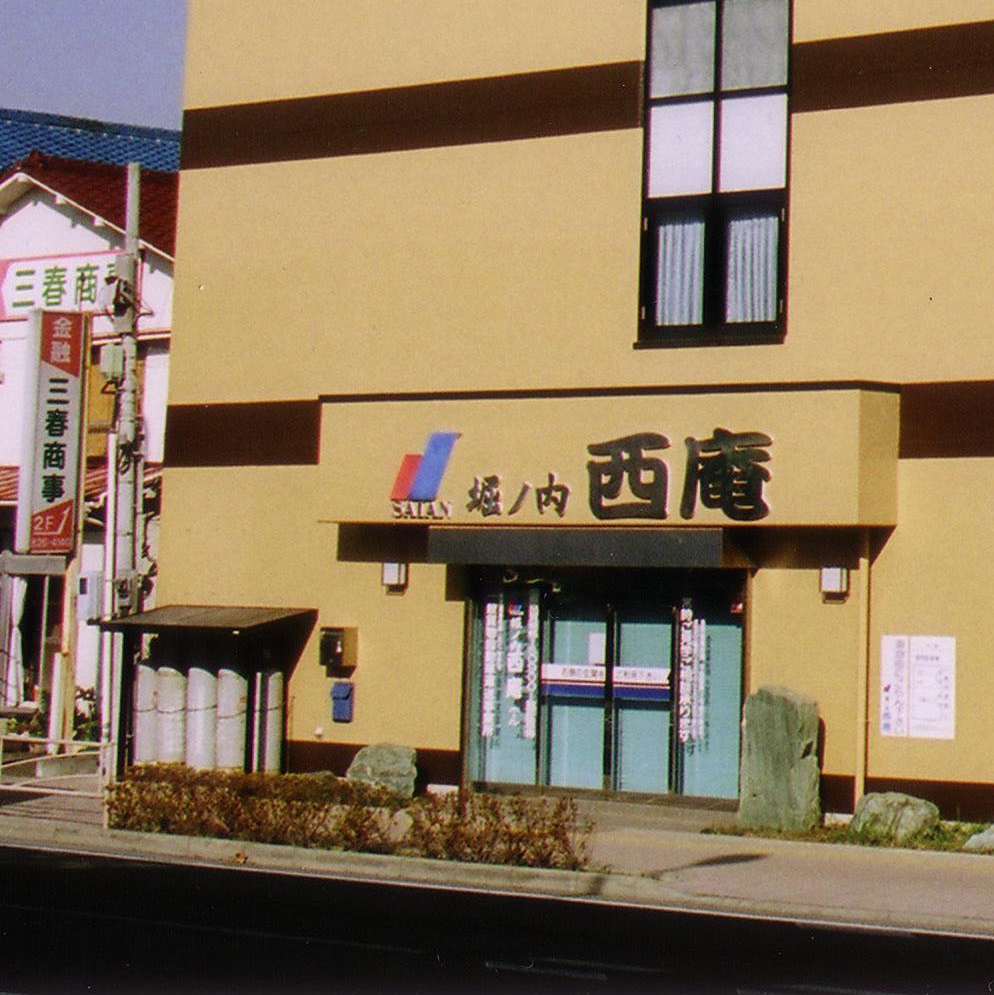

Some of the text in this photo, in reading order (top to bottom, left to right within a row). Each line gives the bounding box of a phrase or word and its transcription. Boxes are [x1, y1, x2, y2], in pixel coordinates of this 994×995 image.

[41, 378, 70, 504] 三春商事
[466, 427, 774, 522] 堀ノ内 西庵
[34, 515, 54, 531] 2F
